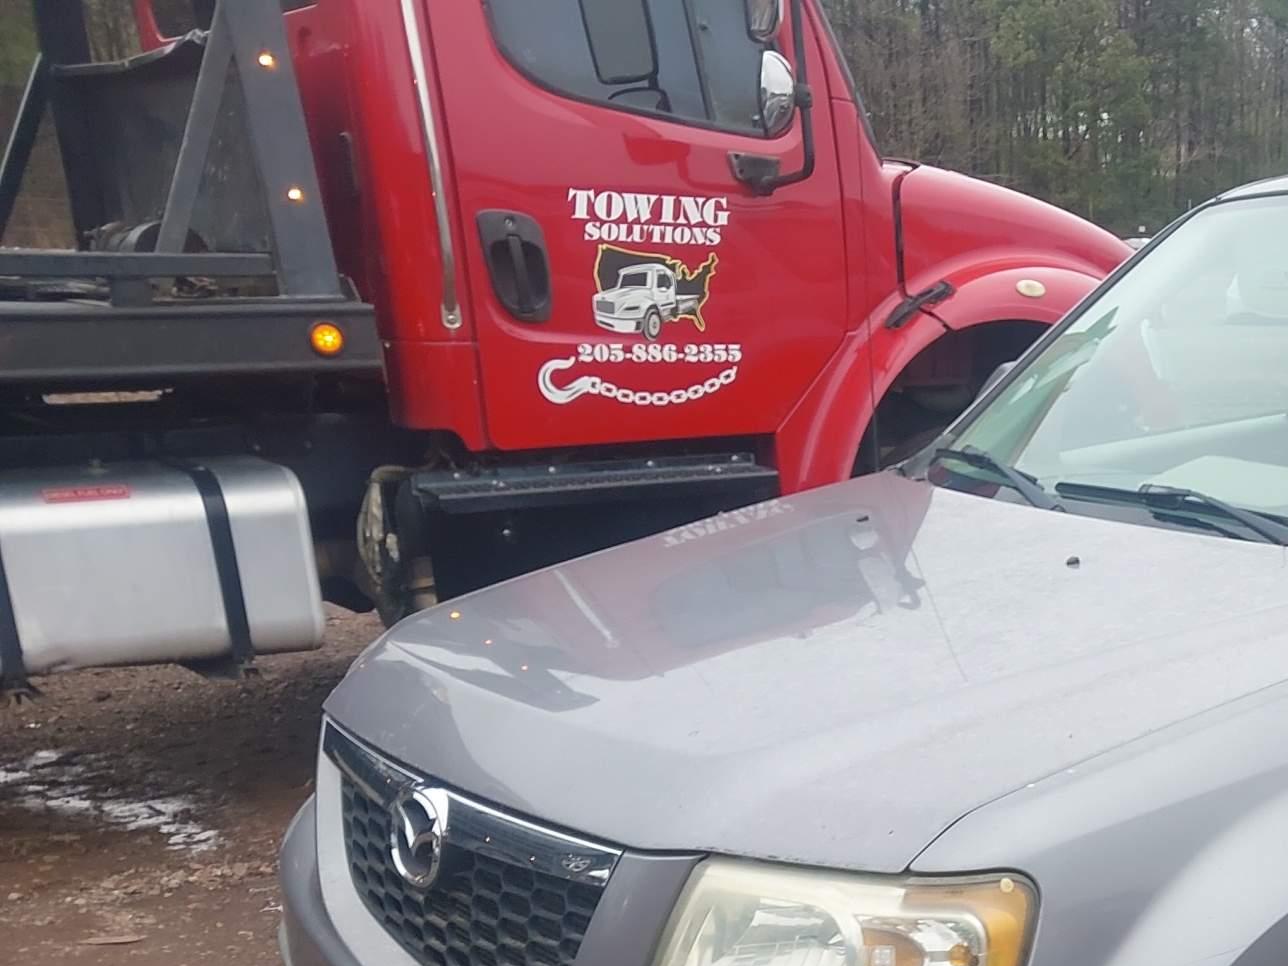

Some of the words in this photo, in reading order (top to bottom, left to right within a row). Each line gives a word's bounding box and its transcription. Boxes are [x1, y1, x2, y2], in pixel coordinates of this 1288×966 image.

[567, 187, 731, 226] TOWING
[584, 221, 721, 246] SOLUTIONS
[577, 343, 742, 364] 205-886-2355
